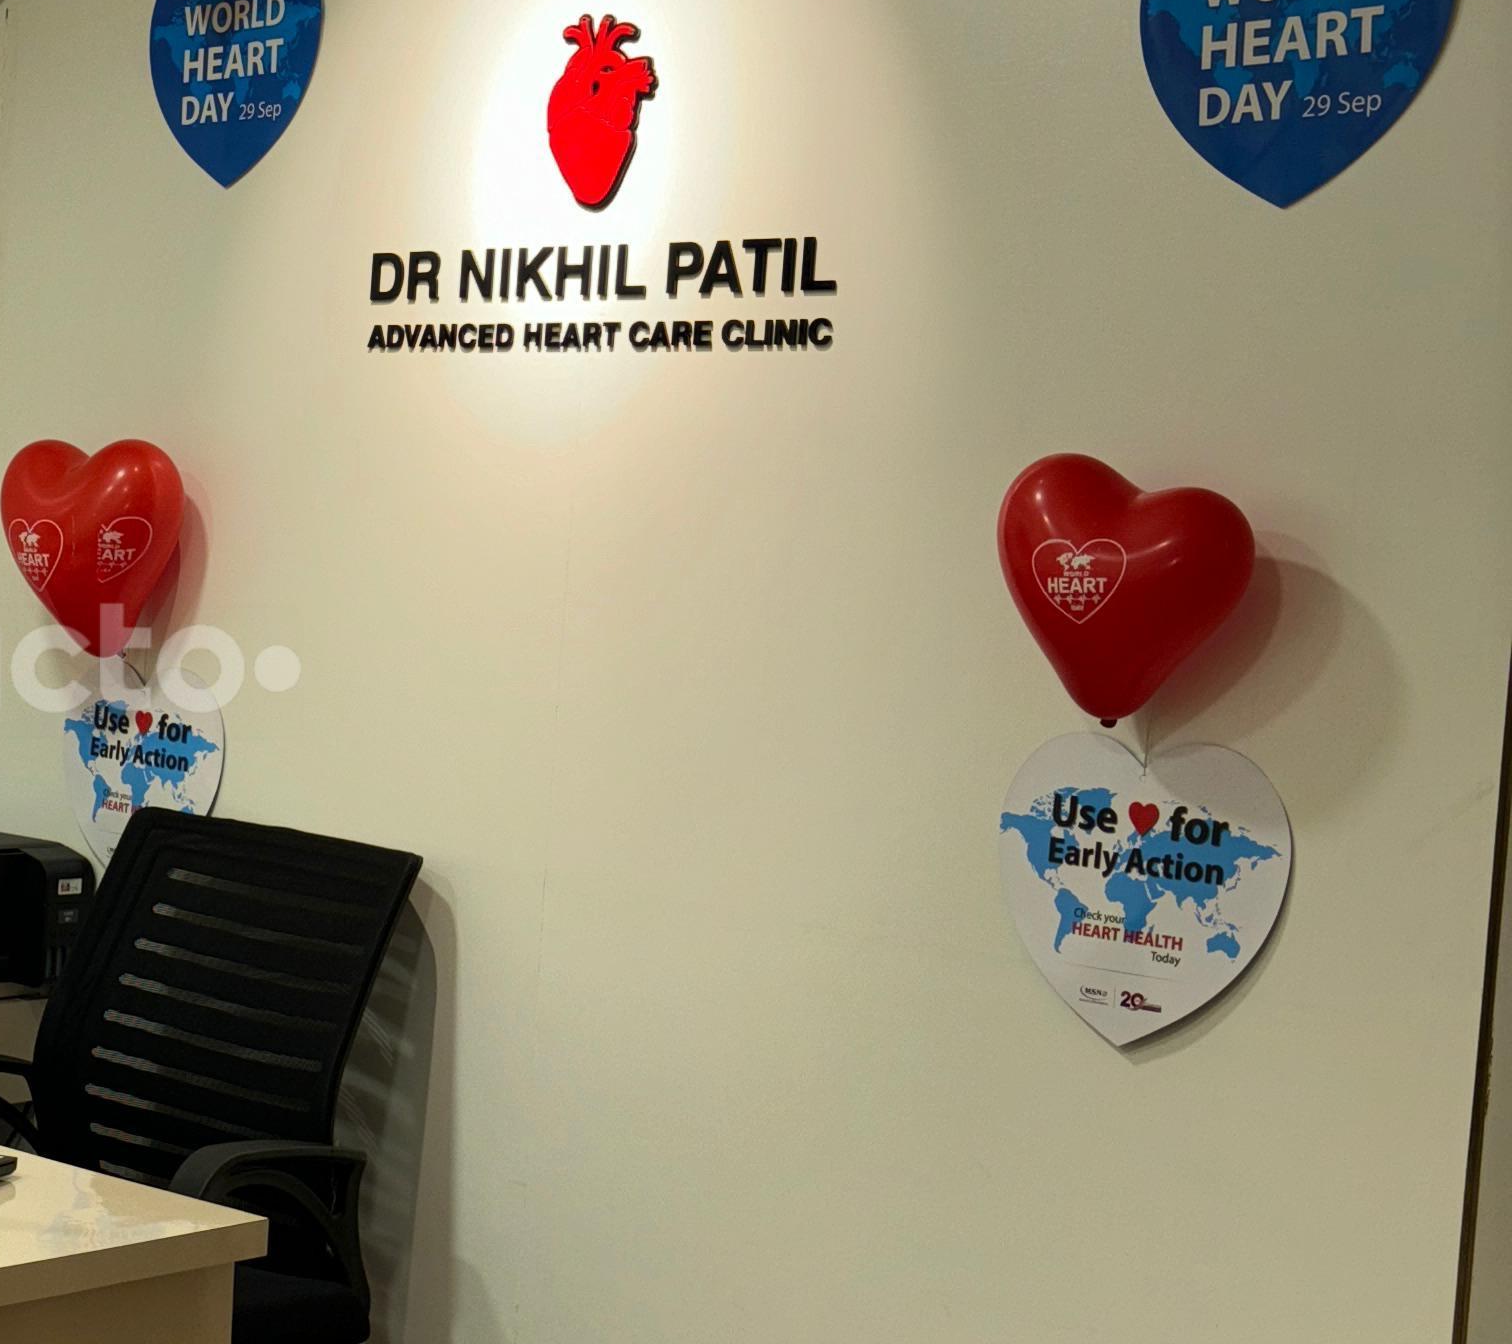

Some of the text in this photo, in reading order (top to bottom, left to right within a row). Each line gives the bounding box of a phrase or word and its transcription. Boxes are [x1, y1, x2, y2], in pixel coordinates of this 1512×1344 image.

[1200, 5, 1385, 70] HEART
[182, 38, 285, 84] HEART
[181, 91, 282, 126] DAY 29 Sep
[1198, 80, 1382, 127] DAY 29 Sep
[369, 236, 837, 302] DR NIKHIL PATIL
[367, 318, 834, 353] ADVANCED HEART CARE CLINIC
[1048, 577, 1107, 593] HEART
[94, 703, 192, 744] Use for
[90, 736, 188, 772] Early Action
[102, 799, 129, 813] HEART
[1052, 790, 1229, 847] Use for
[1048, 836, 1224, 886] Early Action
[1074, 907, 1126, 925] Check your
[1072, 921, 1183, 951] HEART HEALTH
[1151, 951, 1181, 967] Today
